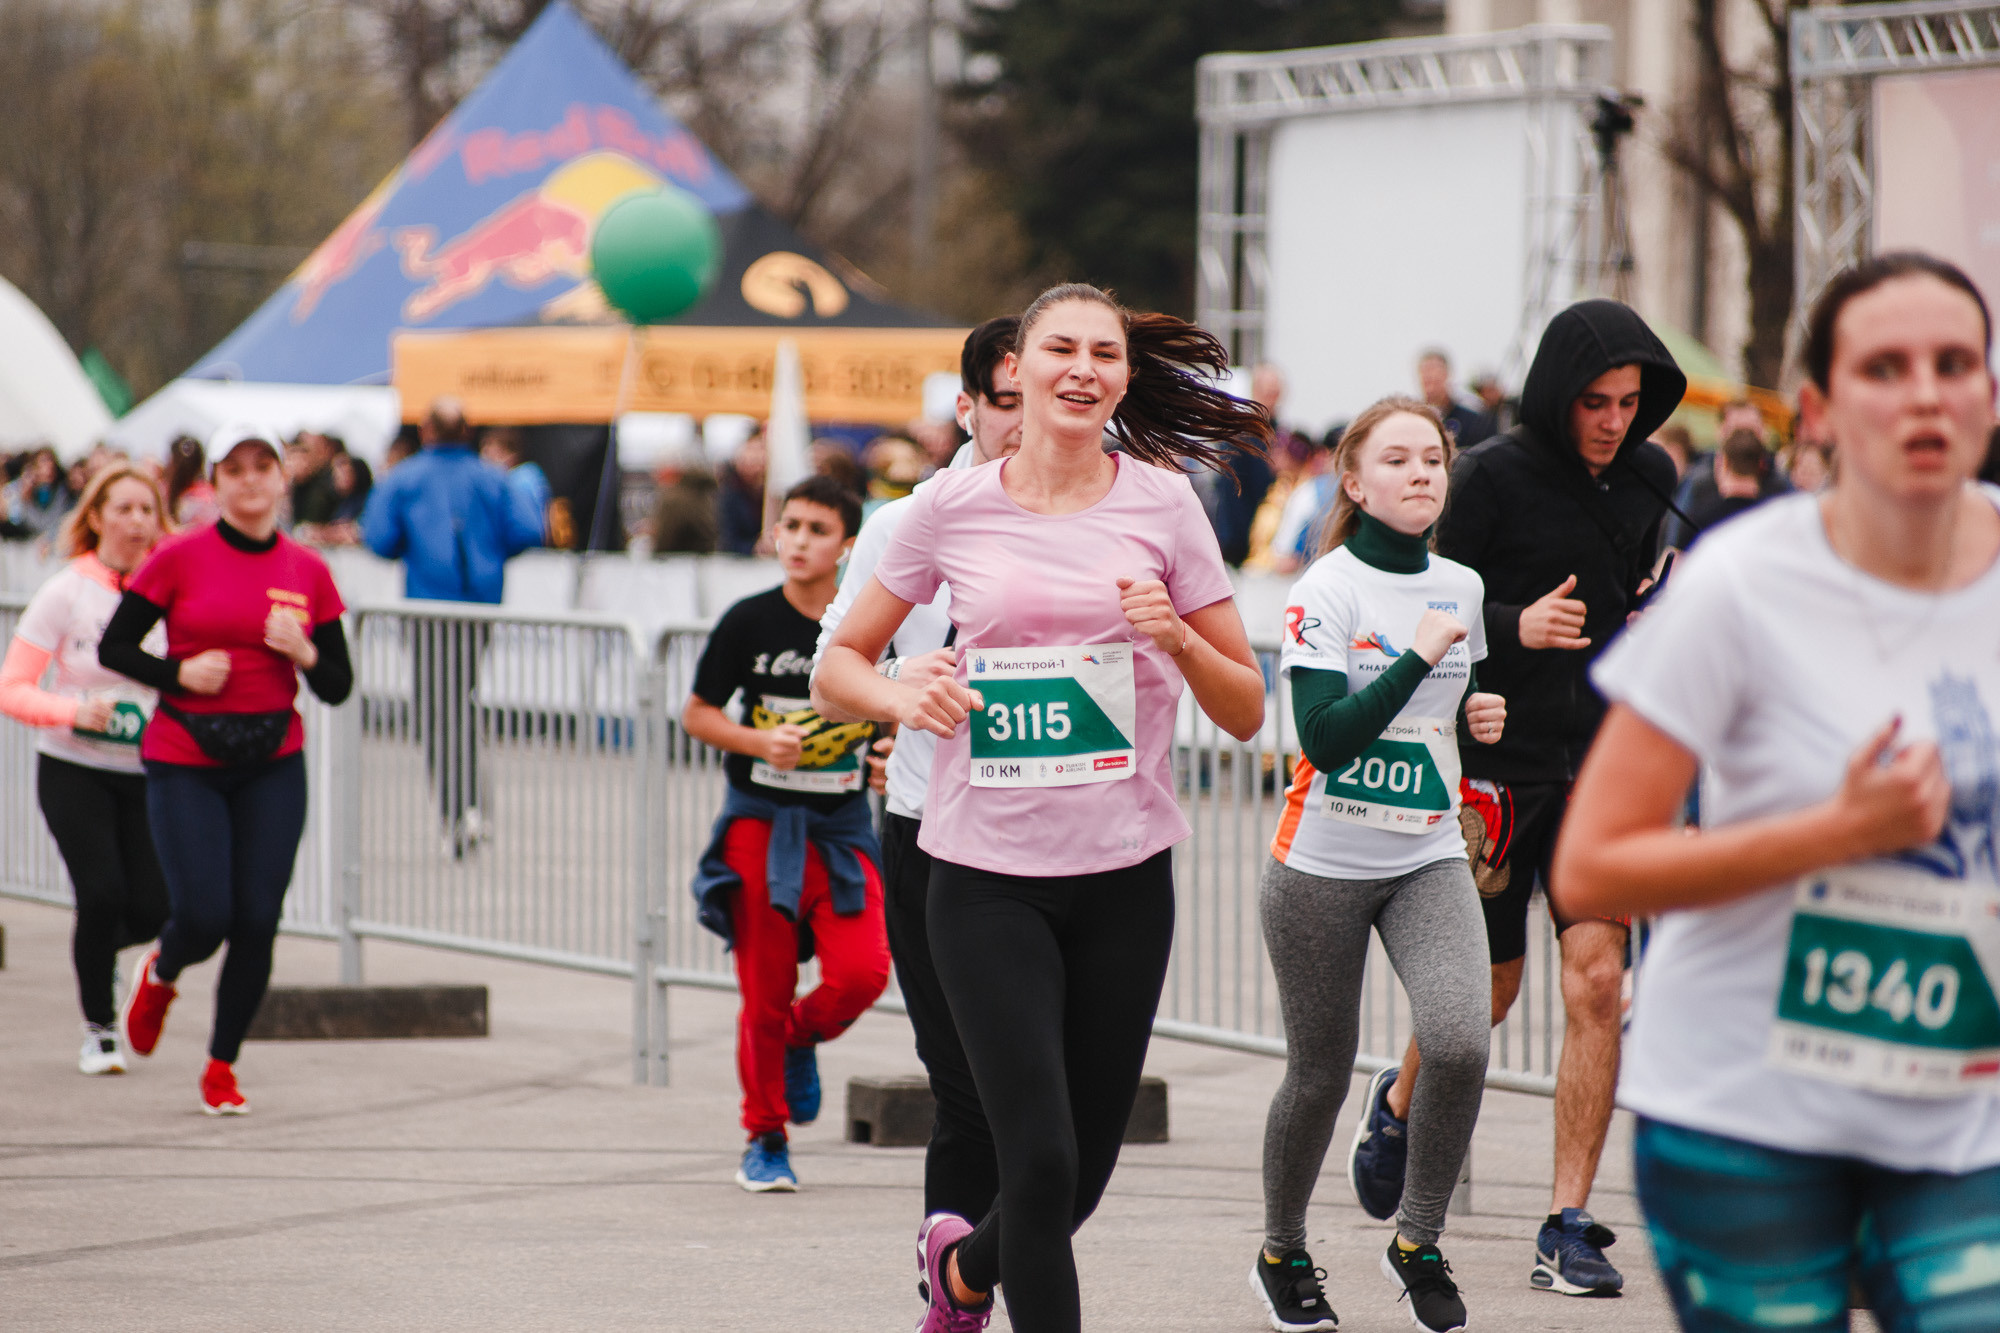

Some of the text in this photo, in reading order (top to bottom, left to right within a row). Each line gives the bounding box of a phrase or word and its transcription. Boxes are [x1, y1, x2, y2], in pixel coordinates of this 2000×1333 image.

[992, 659, 1065, 671] Жилстрой-1
[106, 711, 141, 740] 09
[987, 702, 1071, 741] 3115
[1386, 726, 1421, 735] строй-1
[980, 765, 1020, 778] 10 KM
[1337, 757, 1423, 794] 2001
[1330, 802, 1367, 817] 10 KM
[1803, 947, 1961, 1030] 1340
